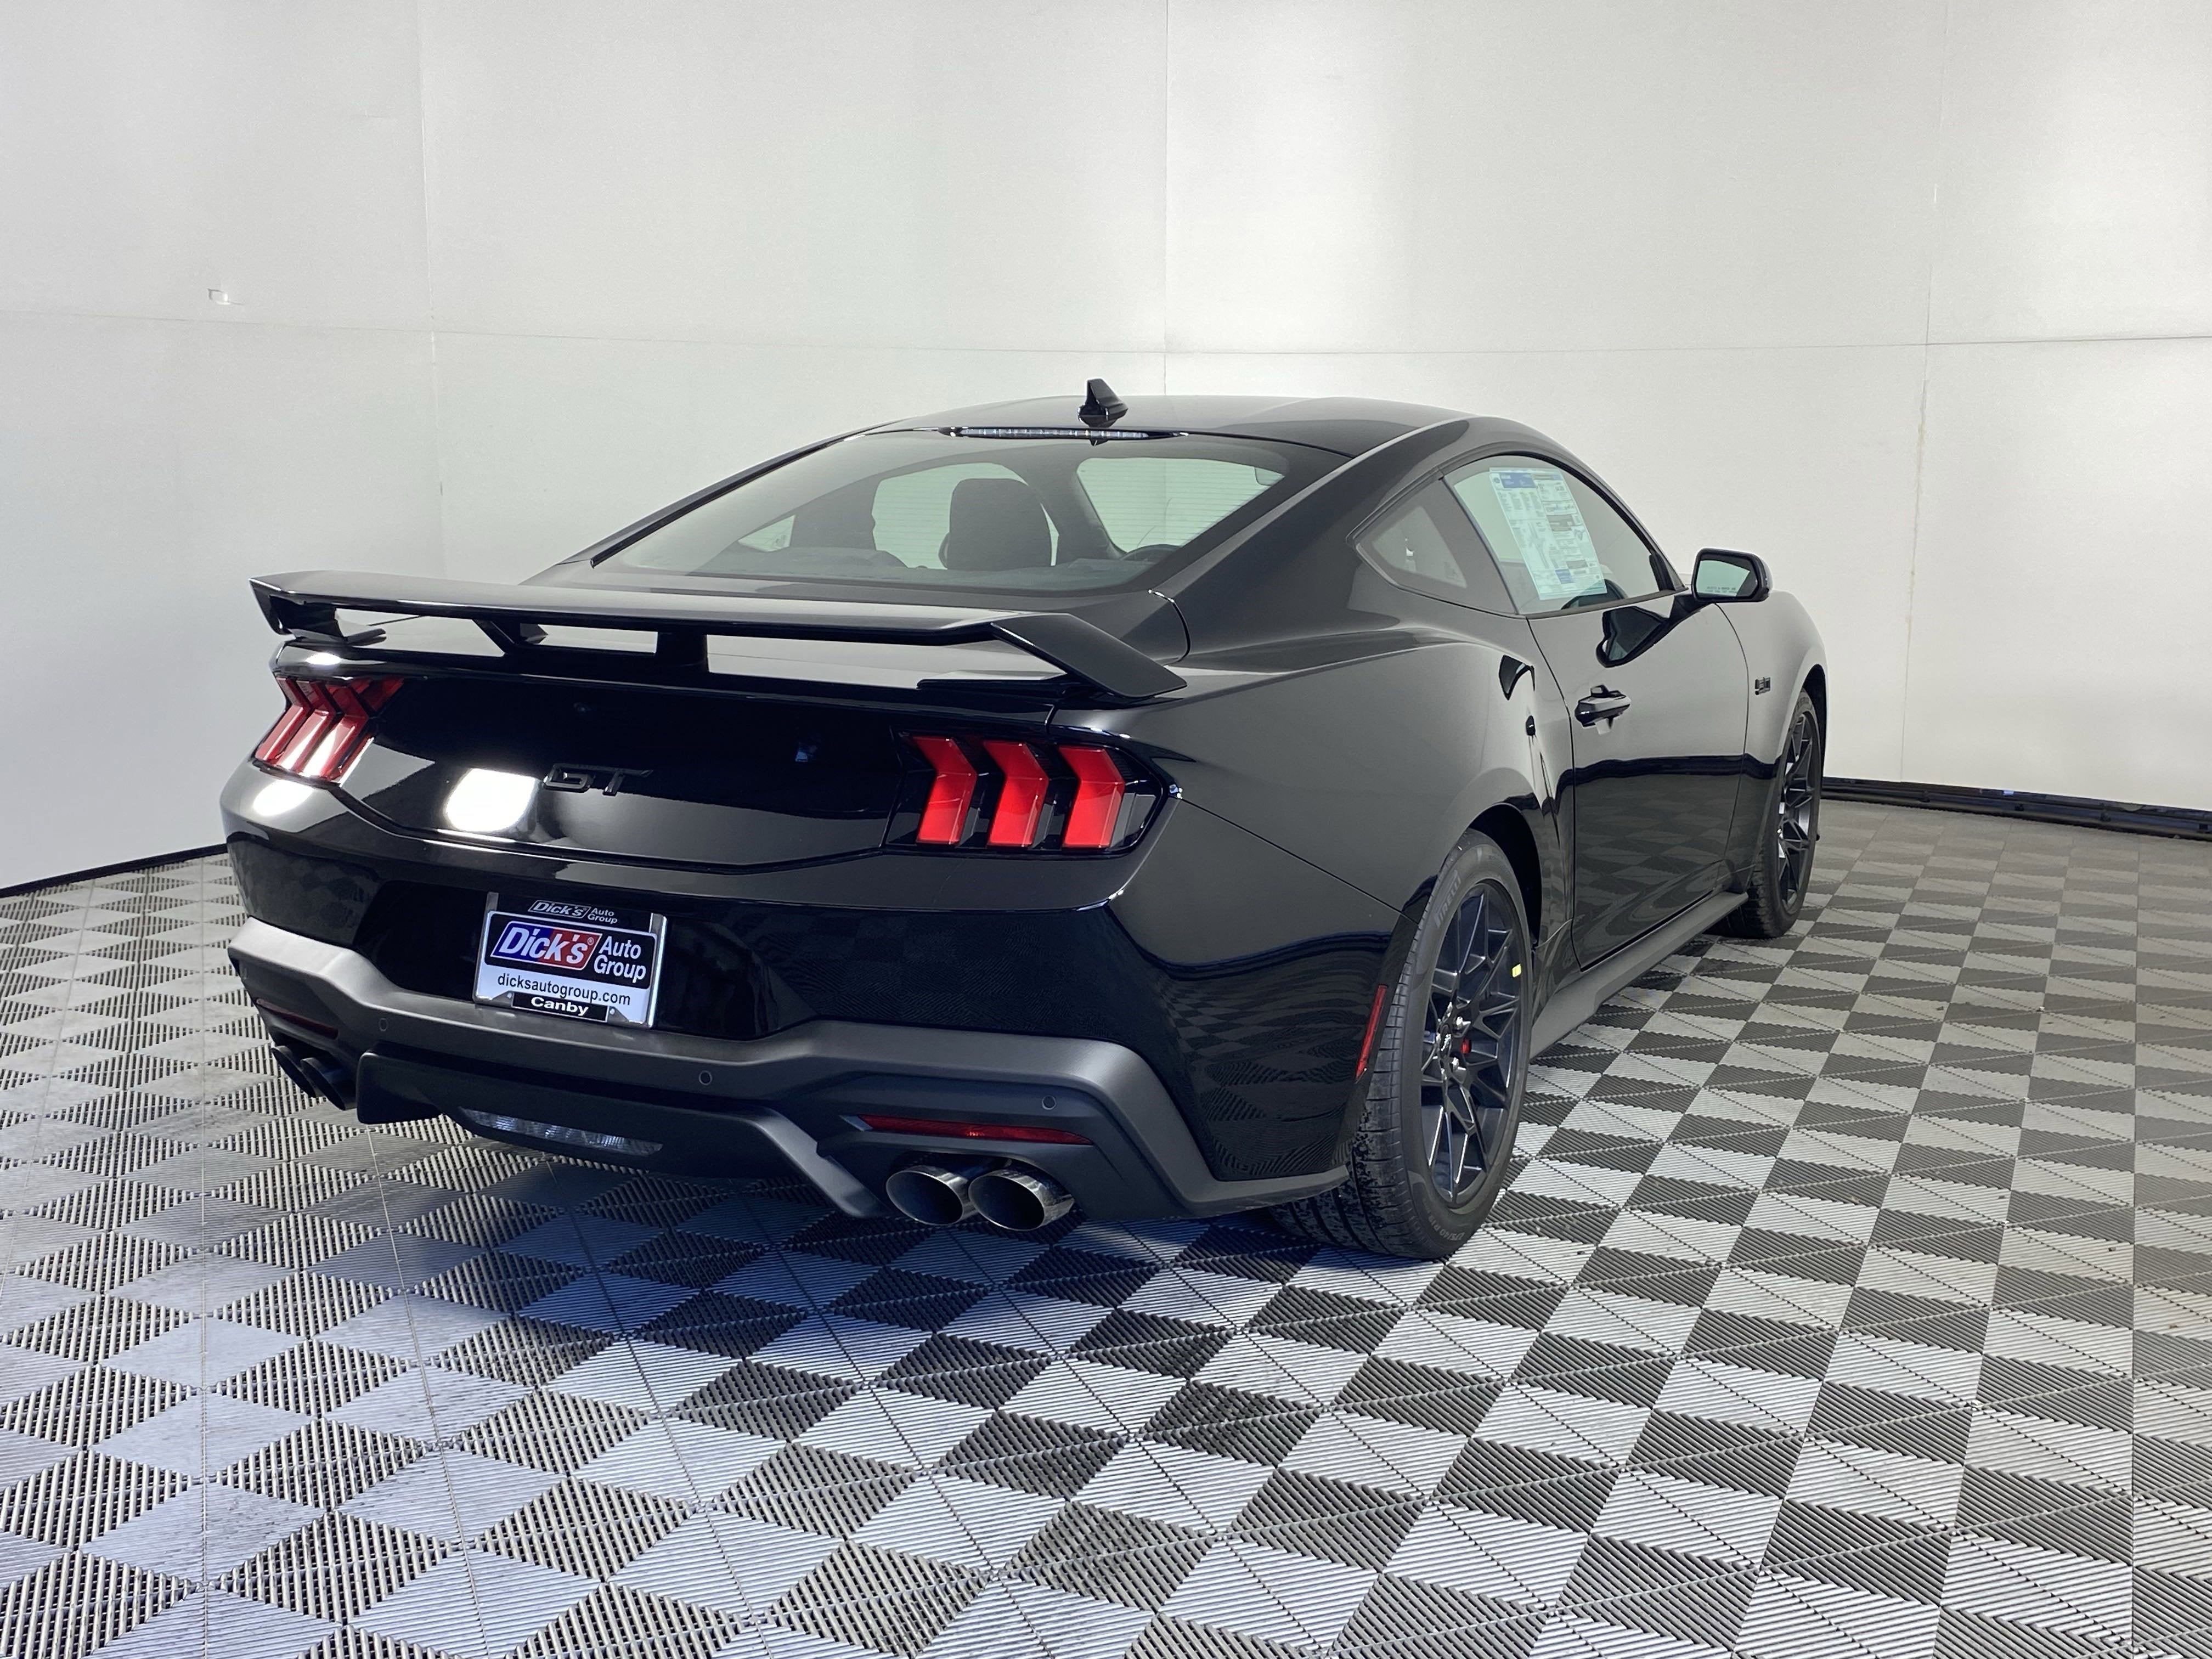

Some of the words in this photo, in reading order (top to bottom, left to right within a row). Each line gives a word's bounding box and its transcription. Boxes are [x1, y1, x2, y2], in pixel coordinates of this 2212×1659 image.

[542, 763, 653, 796] GT
[533, 902, 584, 916] Dick's
[588, 913, 618, 924] Group
[590, 907, 614, 917] Auto
[499, 927, 588, 964] Dick's
[599, 935, 641, 959] Auto
[594, 955, 646, 983] Group
[498, 973, 630, 1006] dicksautogroup.com
[531, 997, 589, 1016] Canby
